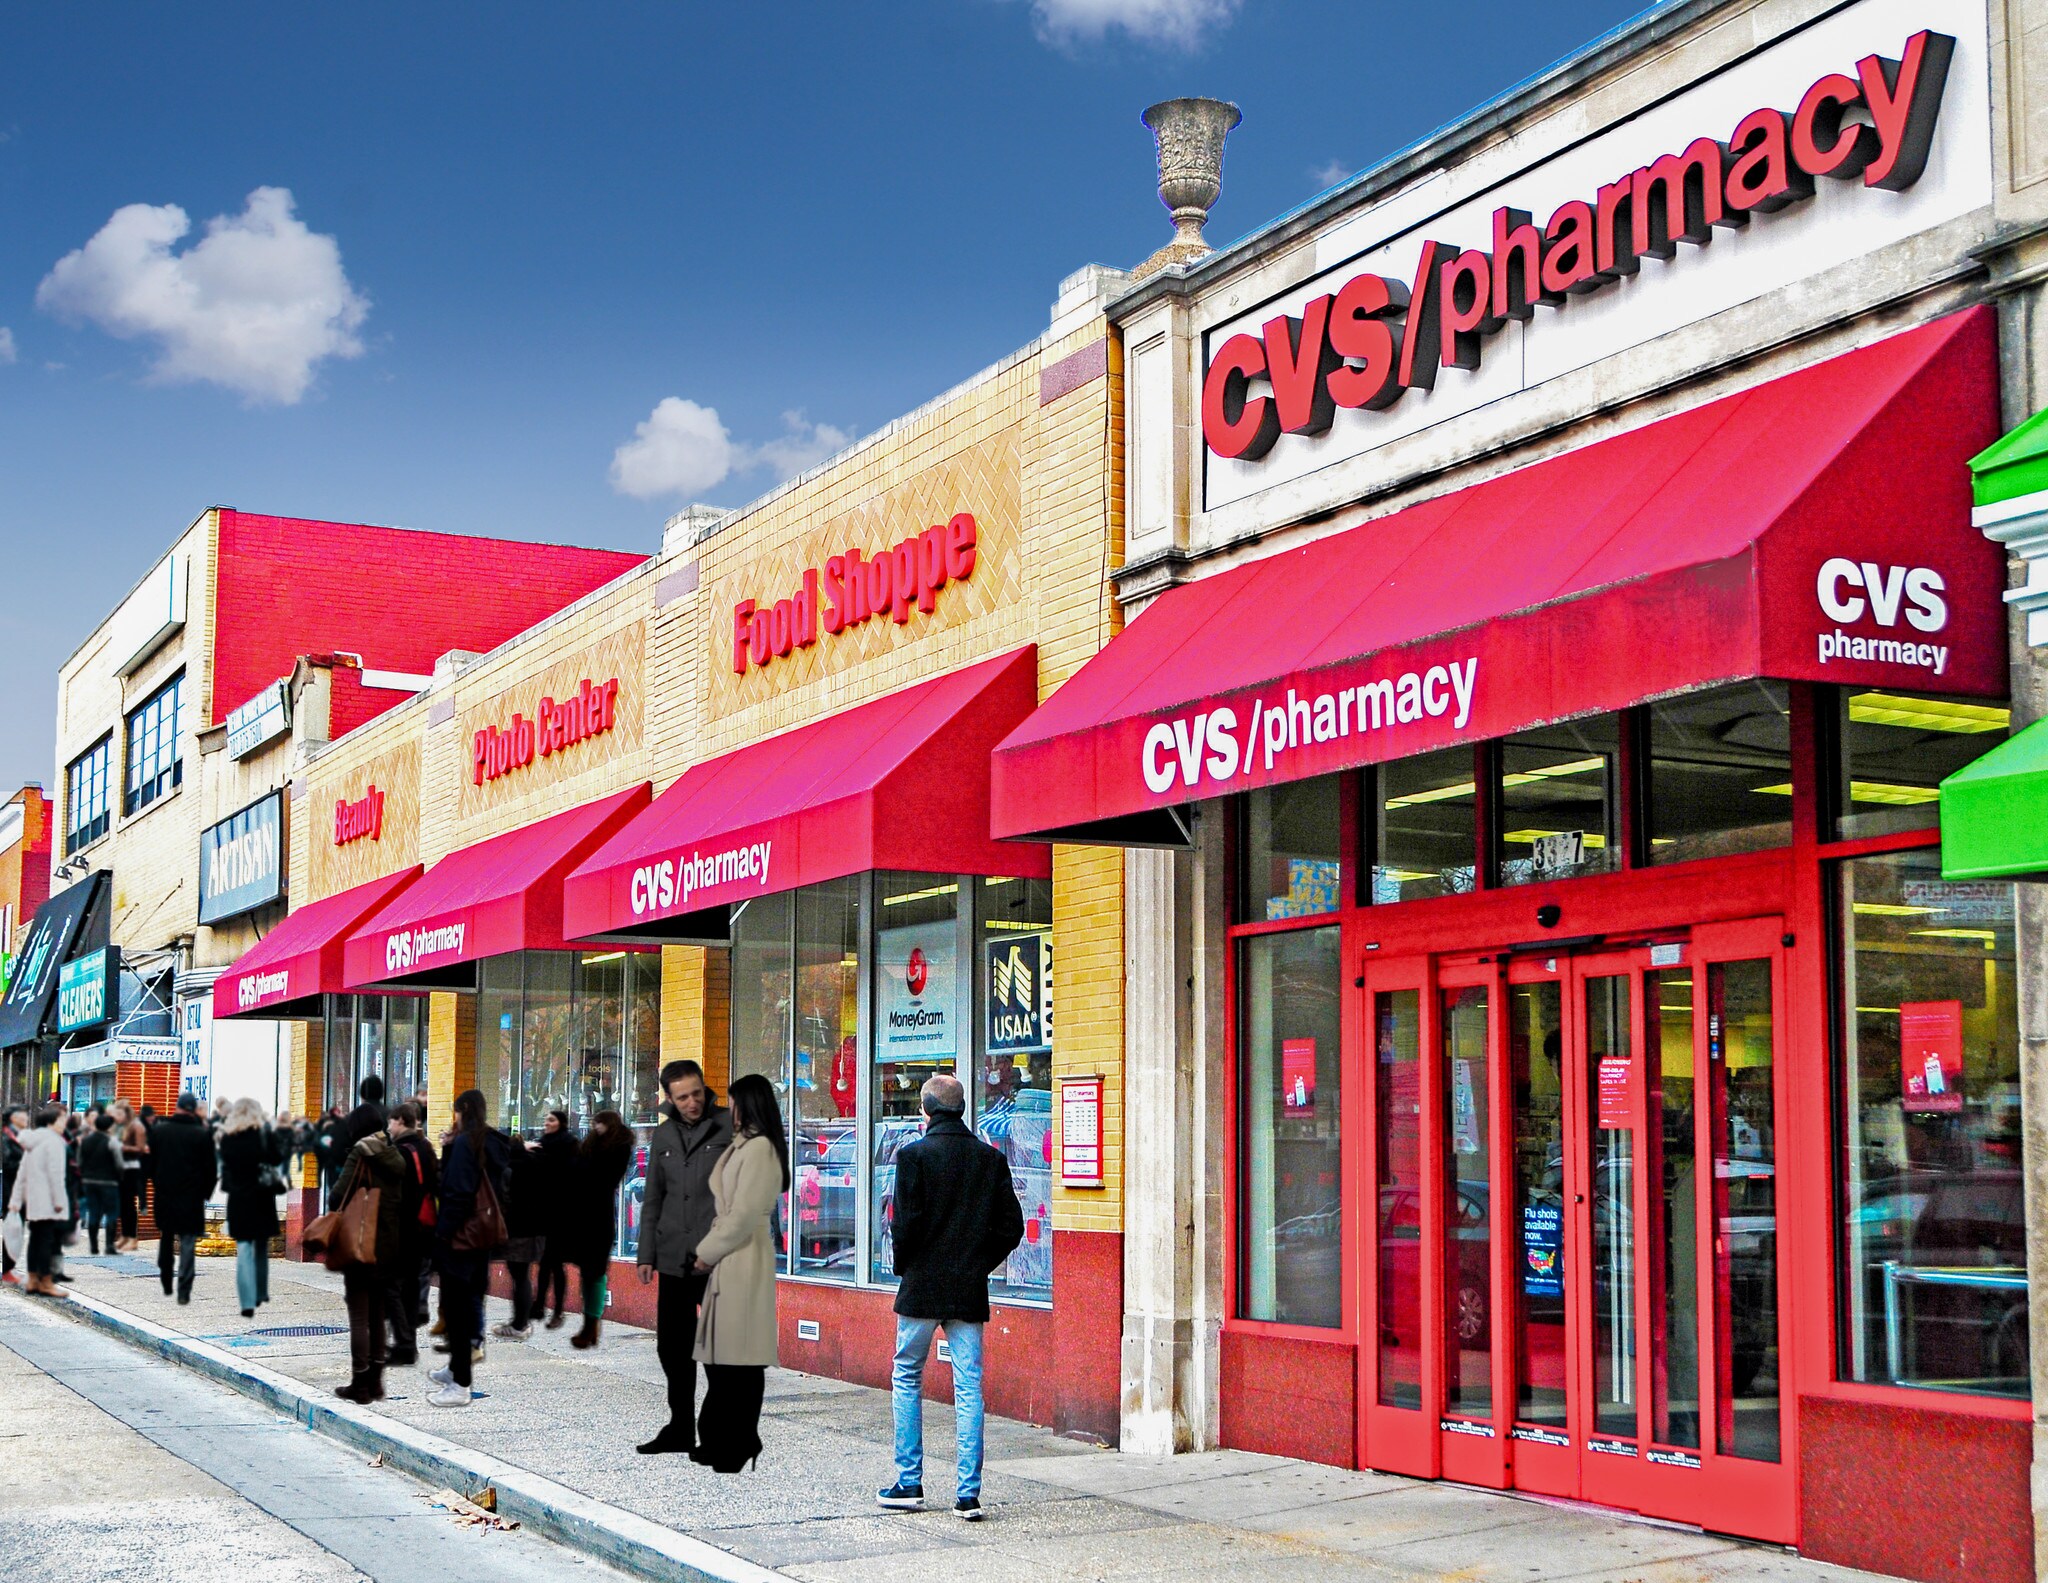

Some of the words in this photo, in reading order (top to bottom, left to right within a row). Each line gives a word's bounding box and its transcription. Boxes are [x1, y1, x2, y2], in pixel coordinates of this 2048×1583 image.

[1203, 29, 1956, 460] CVS/pharmacy
[733, 569, 817, 674] Food
[823, 513, 977, 634] Shoppe
[1817, 558, 1947, 632] CVS
[1817, 631, 1948, 675] pharmacy
[473, 713, 535, 786] Photo
[537, 678, 618, 757] Center
[334, 785, 385, 846] Beauty
[207, 822, 273, 899] ARTISAN
[631, 841, 772, 914] CVS/pharmacy
[386, 923, 465, 971] CVS/pharmacy
[60, 980, 104, 1027] CLEANERS
[889, 1009, 944, 1031] MoneyGram
[126, 1045, 175, 1056] Cleaners
[994, 1014, 1033, 1042] USAA
[1525, 1208, 1536, 1218] Flu
[1537, 1208, 1558, 1219] shots
[1525, 1220, 1557, 1231] available
